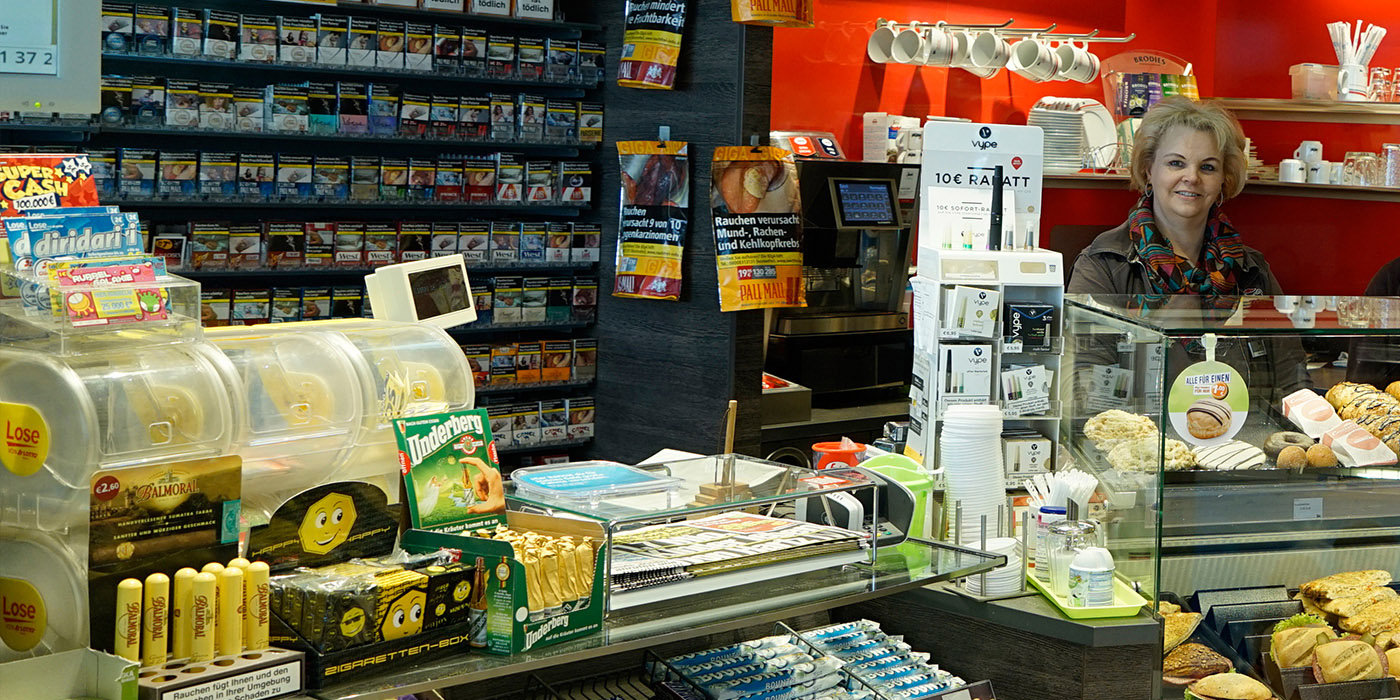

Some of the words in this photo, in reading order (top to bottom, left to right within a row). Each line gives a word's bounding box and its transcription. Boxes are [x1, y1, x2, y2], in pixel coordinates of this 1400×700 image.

[522, 4, 549, 13] tödlich
[649, 0, 685, 13] mindert
[15, 51, 37, 65] 37
[43, 52, 53, 65] 2
[1133, 55, 1166, 65] BRODIES
[972, 140, 998, 150] vype
[0, 165, 54, 181] SUPER
[936, 173, 963, 185] 10€
[969, 174, 1031, 187] RAATT
[3, 177, 69, 200] CASH
[951, 205, 1008, 213] SOFORT-RAT
[28, 222, 48, 230] Lose
[649, 218, 655, 228] 9
[655, 220, 668, 228] von
[670, 220, 682, 230] 10
[715, 216, 756, 227] Rauchen
[757, 214, 800, 225] verursacht
[716, 228, 752, 239] Mund-,
[753, 227, 787, 237] Rachen-
[33, 226, 121, 258] diridari
[718, 240, 738, 251] und
[739, 238, 800, 250] Kehlkopfkrebs
[370, 252, 391, 260] West
[404, 252, 424, 260] West
[463, 251, 483, 260] West
[495, 251, 515, 259] West
[523, 251, 542, 259] West
[71, 271, 112, 284] RUBBEL
[740, 283, 762, 301] PALL
[763, 282, 786, 299] MALL
[974, 299, 990, 307] vype
[1012, 312, 1022, 338] vype
[968, 356, 988, 364] vype
[1186, 376, 1198, 385] ALLE
[1200, 375, 1210, 384] FÜR
[1211, 374, 1230, 383] EINEN
[6, 420, 40, 445] Lose
[516, 431, 536, 439] CAMEL
[544, 428, 564, 436] CAMEL
[571, 425, 591, 434] CAMEL
[406, 414, 484, 467] Underberg
[135, 479, 200, 502] BALMORAL
[444, 523, 464, 534] Kräuter
[465, 520, 485, 530] kommt
[491, 518, 499, 526] an
[2, 596, 36, 620] Lose
[257, 583, 269, 628] BALMORAL
[151, 596, 166, 642] BALMORAL
[194, 595, 209, 640] BALMORAL
[126, 602, 140, 648] BALMORAL
[525, 614, 570, 651] Underberg
[325, 633, 470, 676] ZIGARETTEN-BOX
[173, 686, 211, 700] Rauchen
[212, 682, 230, 692] fügt
[231, 675, 254, 687] Ihnen
[255, 671, 272, 681] und
[273, 667, 289, 677] den
[215, 689, 225, 699] in
[226, 686, 245, 698] Ihrer
[247, 675, 291, 692] Umgebung
[271, 686, 281, 695] zu
